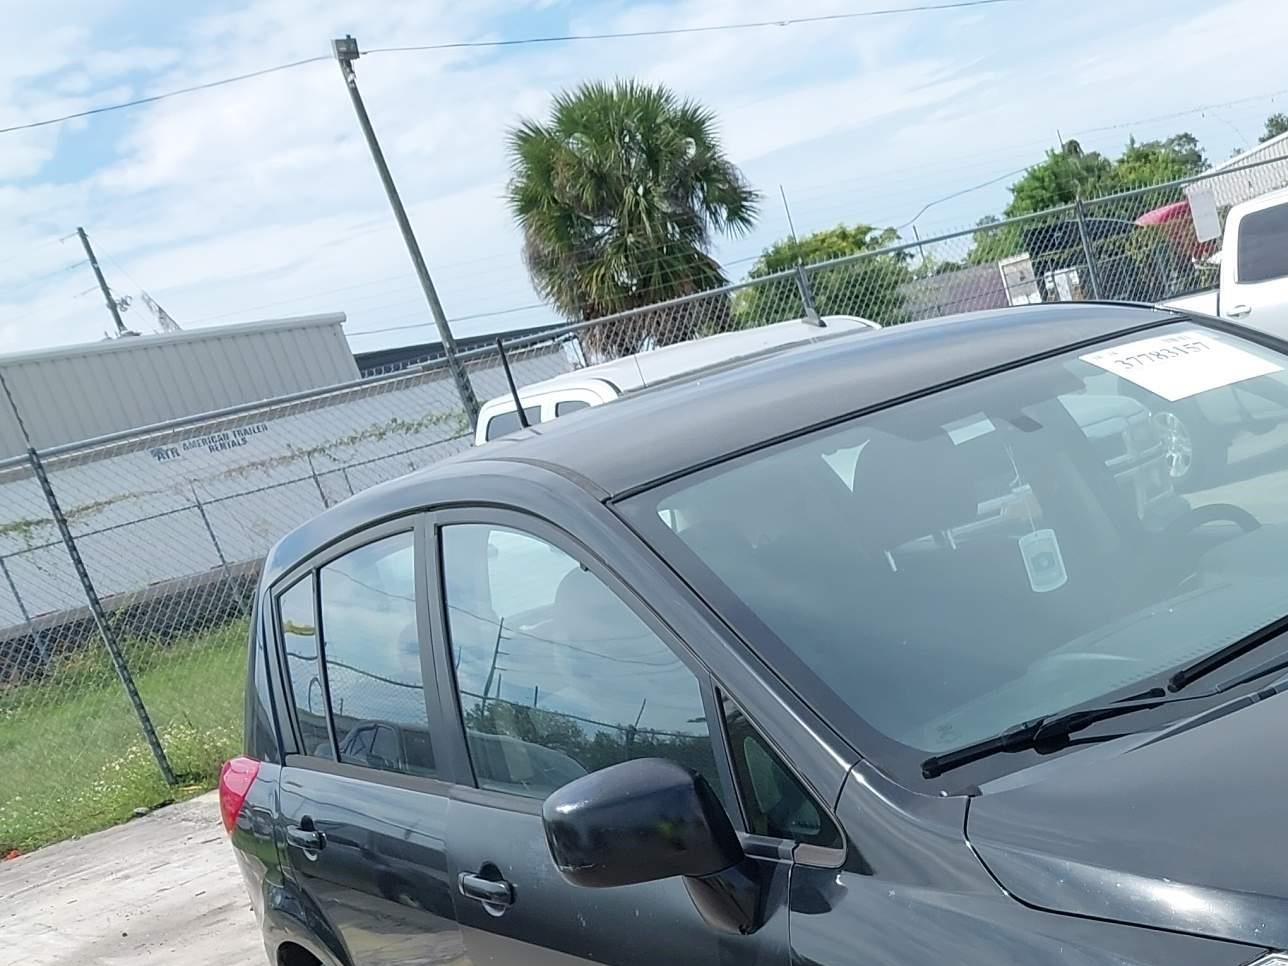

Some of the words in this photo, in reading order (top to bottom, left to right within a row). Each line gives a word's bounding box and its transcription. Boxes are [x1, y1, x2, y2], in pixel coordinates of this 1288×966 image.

[1113, 341, 1211, 369] 37783157
[182, 433, 230, 451] AMERICAN
[232, 423, 268, 438] TRAILER
[208, 437, 248, 453] RENTALS
